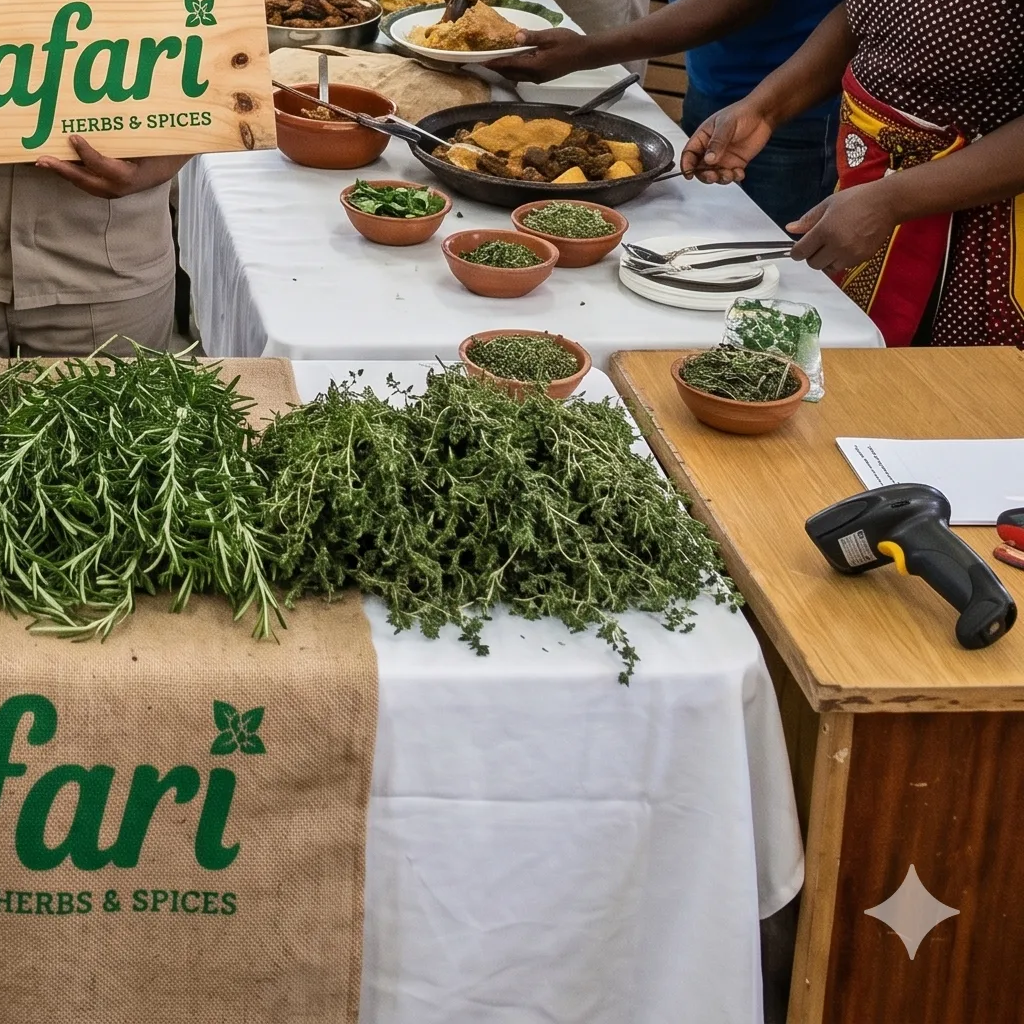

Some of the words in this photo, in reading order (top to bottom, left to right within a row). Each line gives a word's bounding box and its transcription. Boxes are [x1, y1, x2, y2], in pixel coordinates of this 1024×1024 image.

[61, 115, 124, 133] HERBS
[129, 115, 143, 130] &
[146, 111, 212, 129] SPICES
[103, 889, 122, 913] &
[132, 889, 237, 916] SPICES
